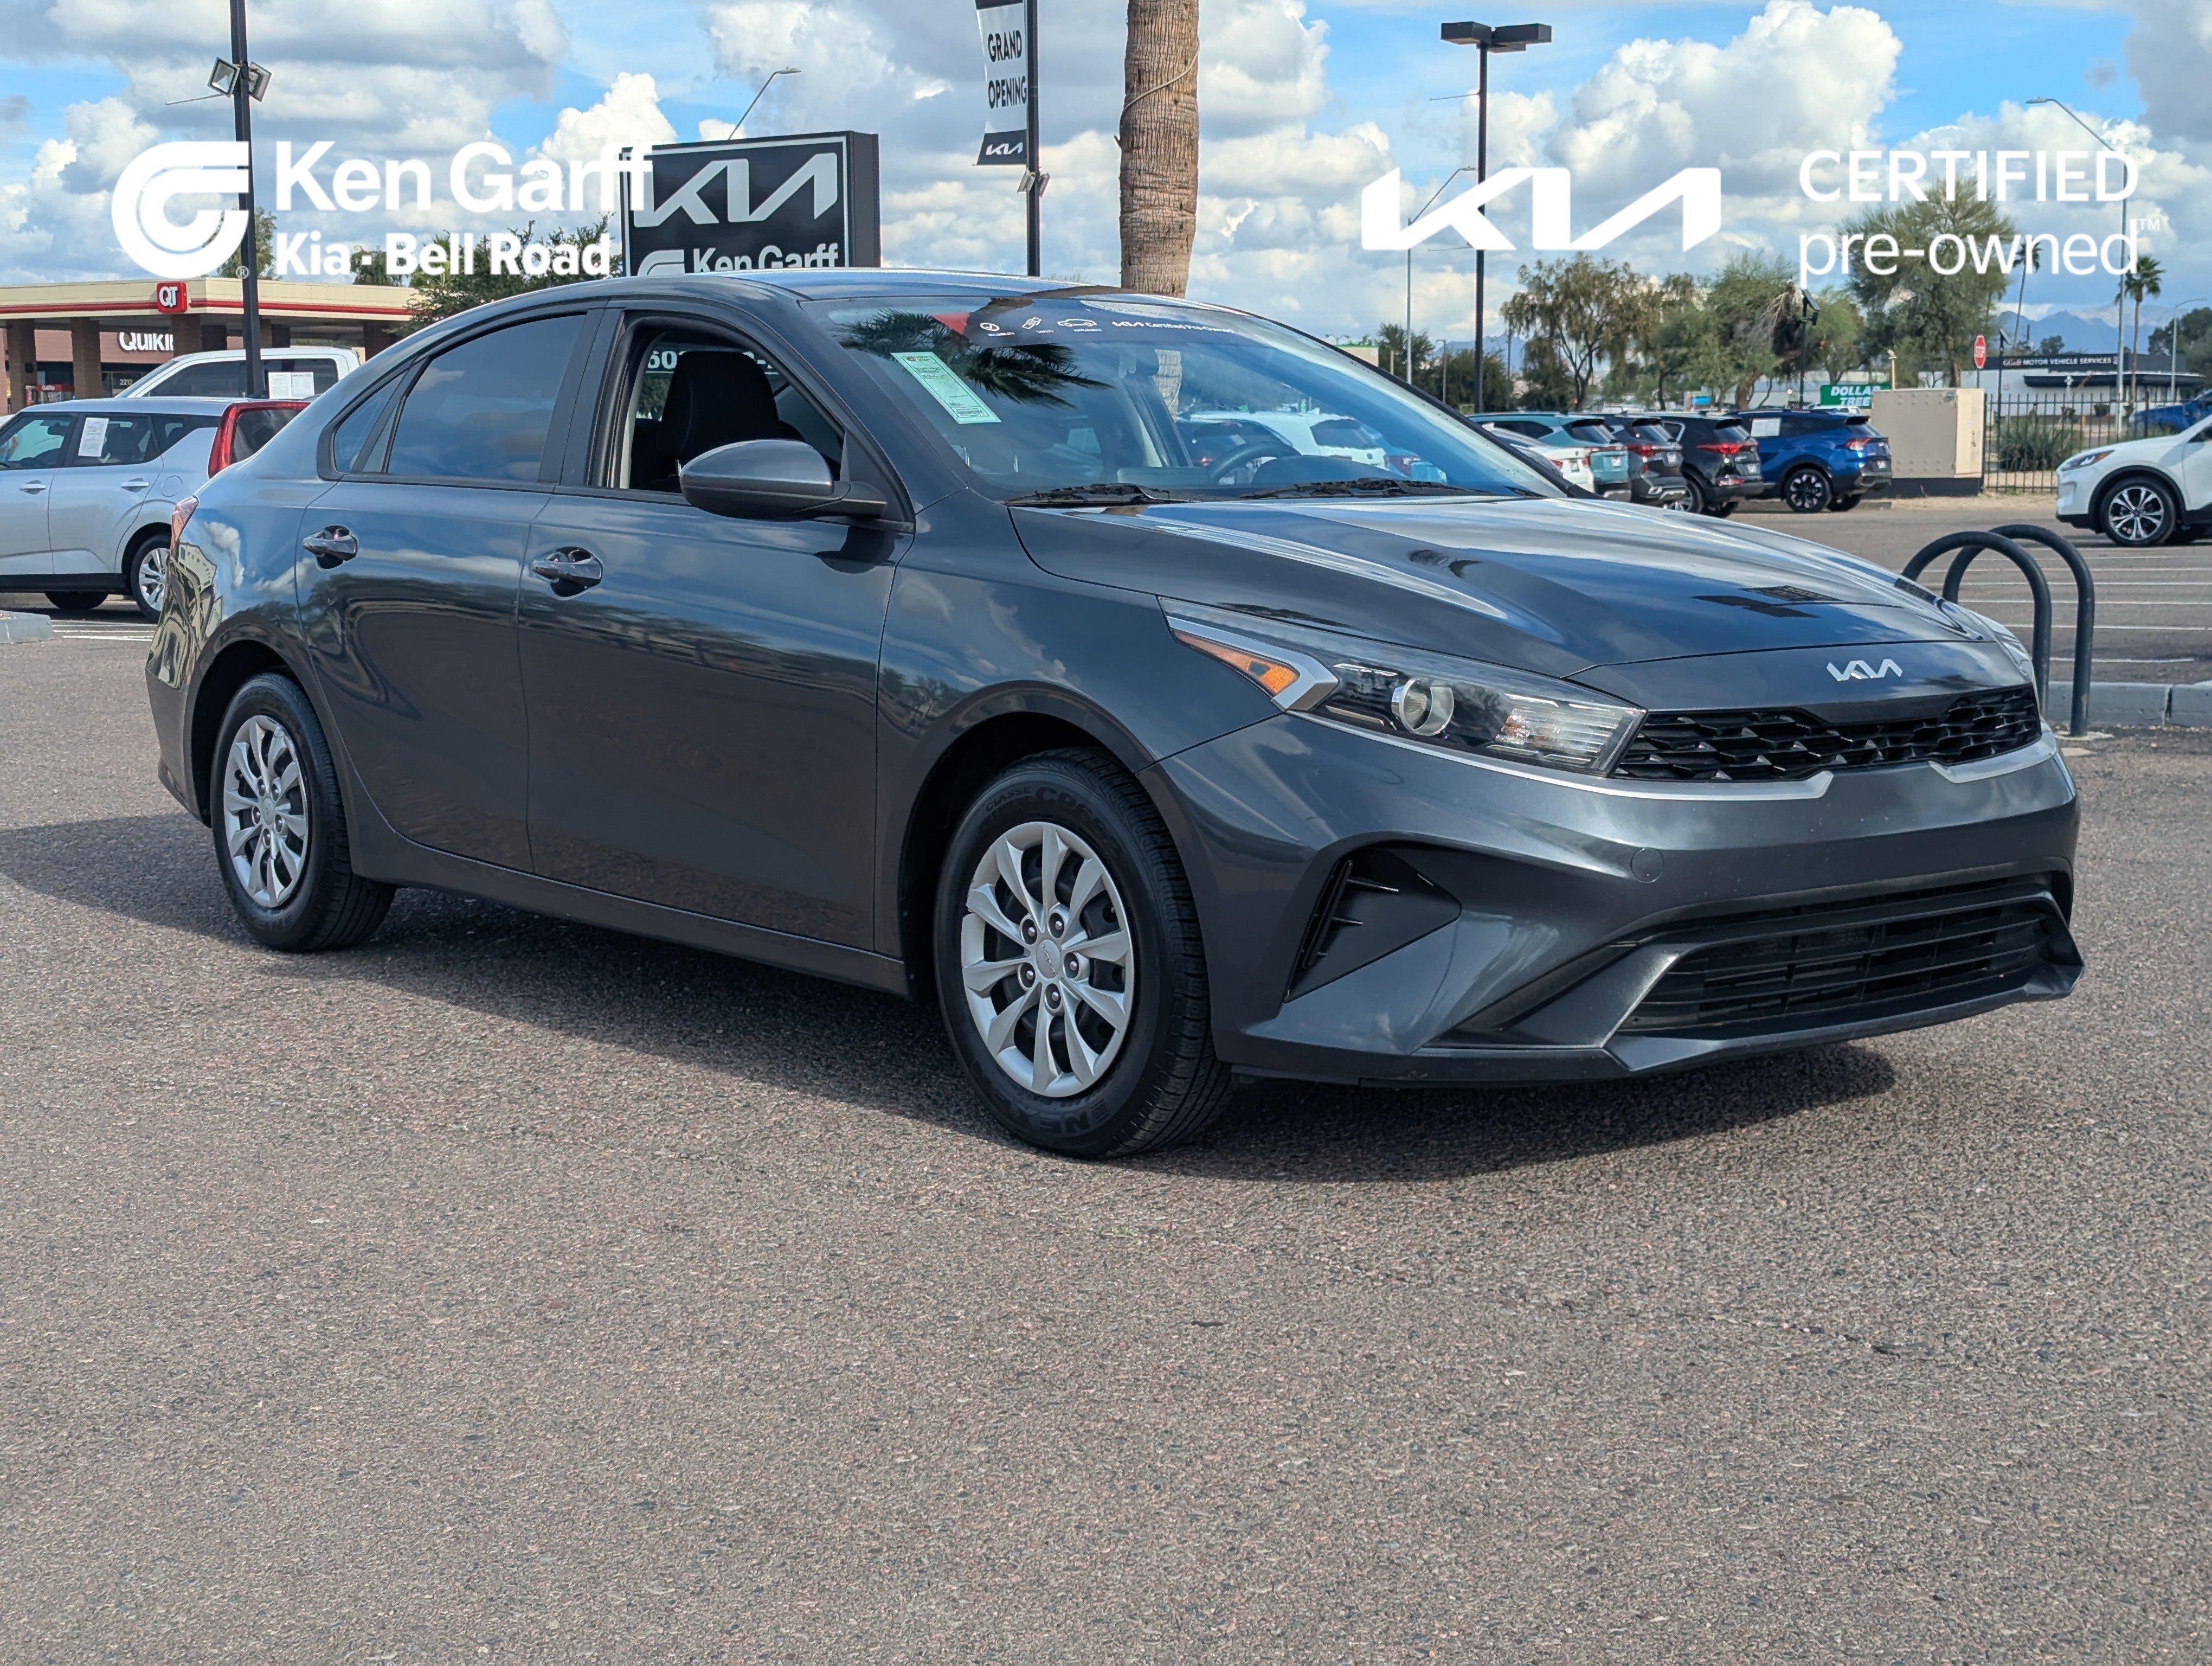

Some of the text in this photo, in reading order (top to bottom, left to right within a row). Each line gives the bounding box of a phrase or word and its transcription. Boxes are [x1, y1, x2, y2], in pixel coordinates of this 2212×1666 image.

[987, 29, 1022, 63] GRAND
[988, 75, 1027, 110] OPENING
[985, 142, 1024, 156] KIA
[633, 152, 838, 228] KIA
[693, 242, 839, 273] Ken Garff
[159, 286, 178, 308] QT
[1840, 396, 1871, 407] TREE
[1826, 658, 1903, 682] KIA
